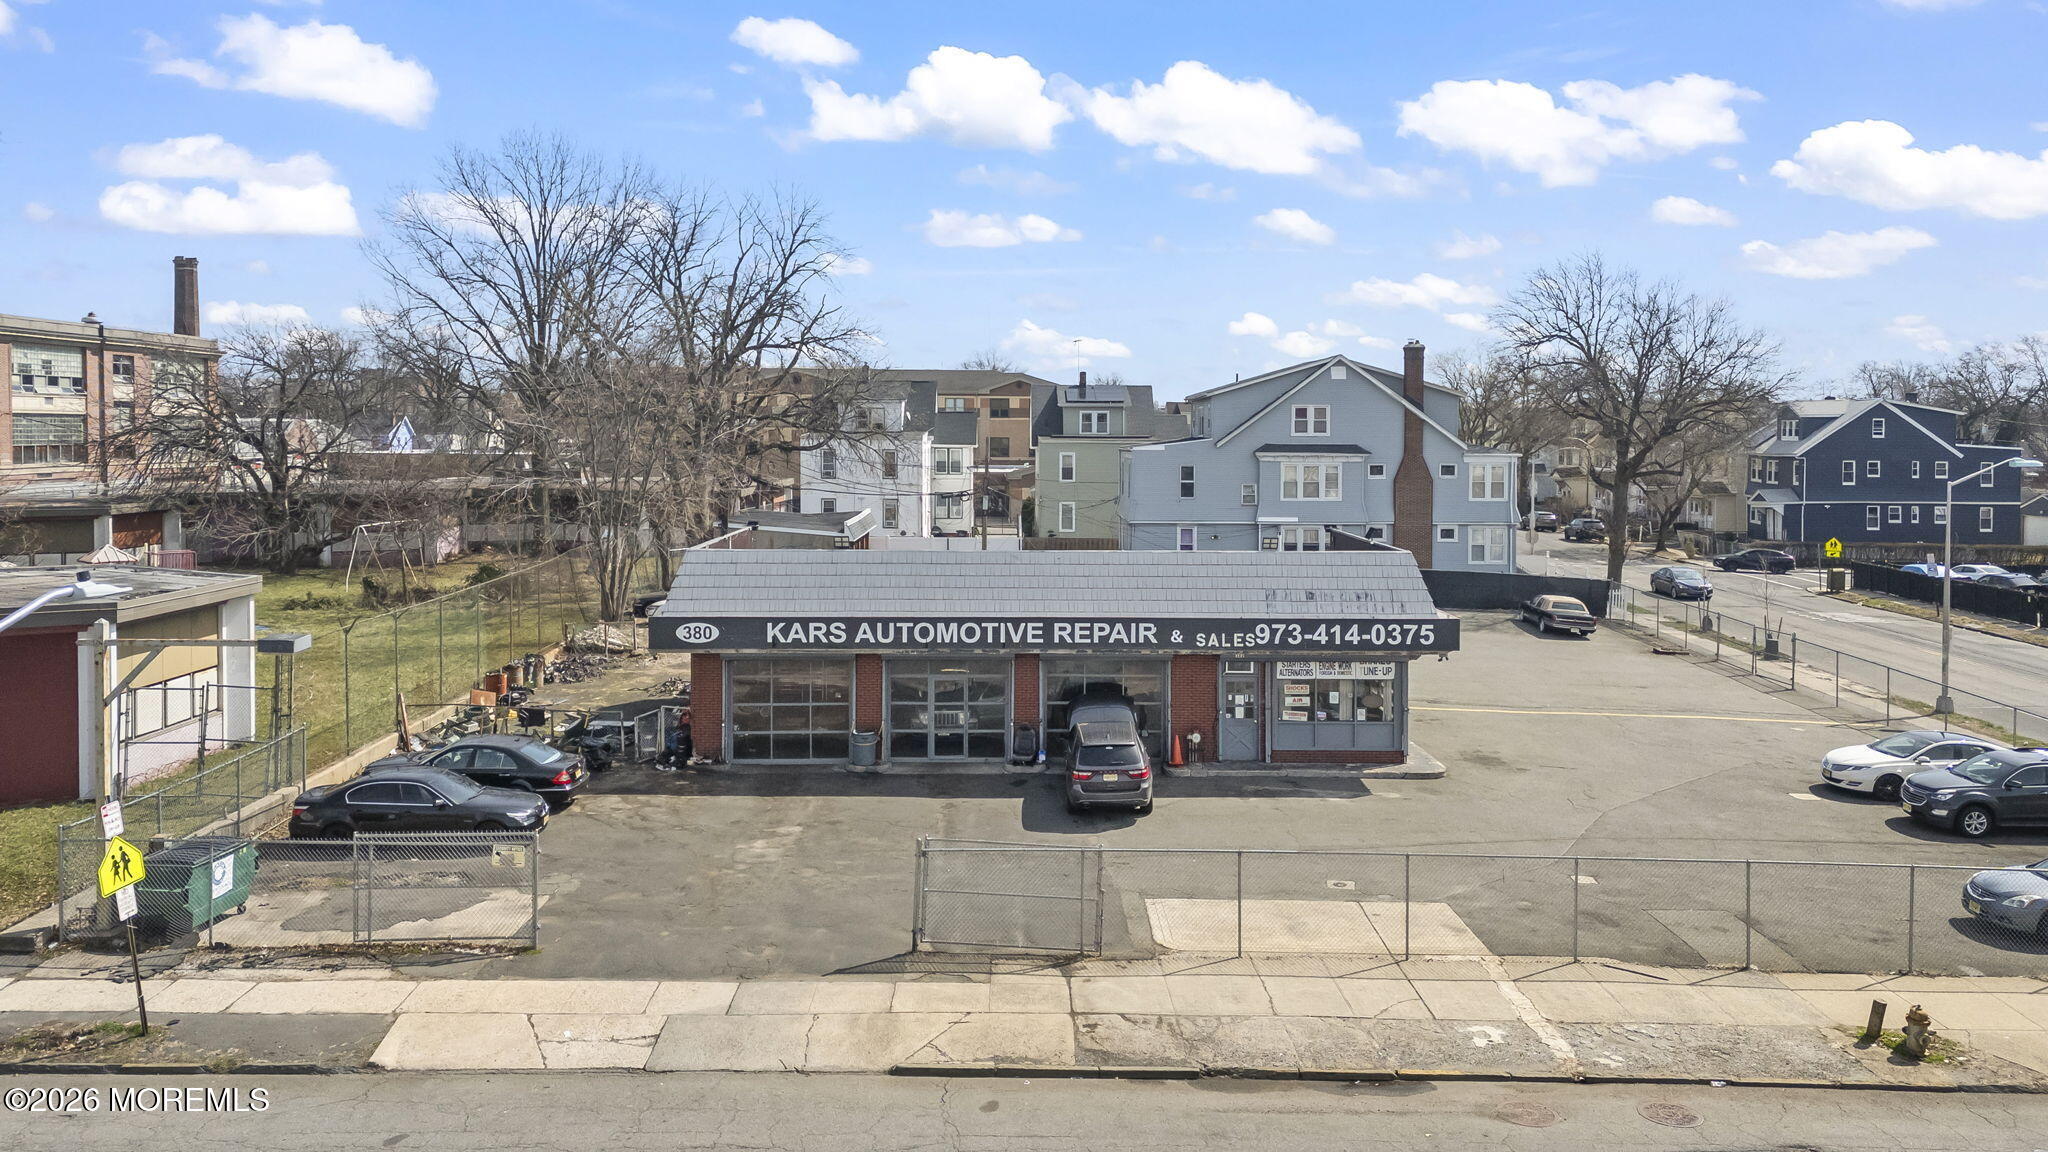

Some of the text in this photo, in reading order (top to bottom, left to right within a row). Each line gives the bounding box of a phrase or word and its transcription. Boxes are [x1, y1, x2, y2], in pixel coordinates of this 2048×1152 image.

[682, 625, 713, 640] 380
[766, 622, 1435, 648] KARS AUTOMOTIVE REPAIR & SALES 973-414-0375
